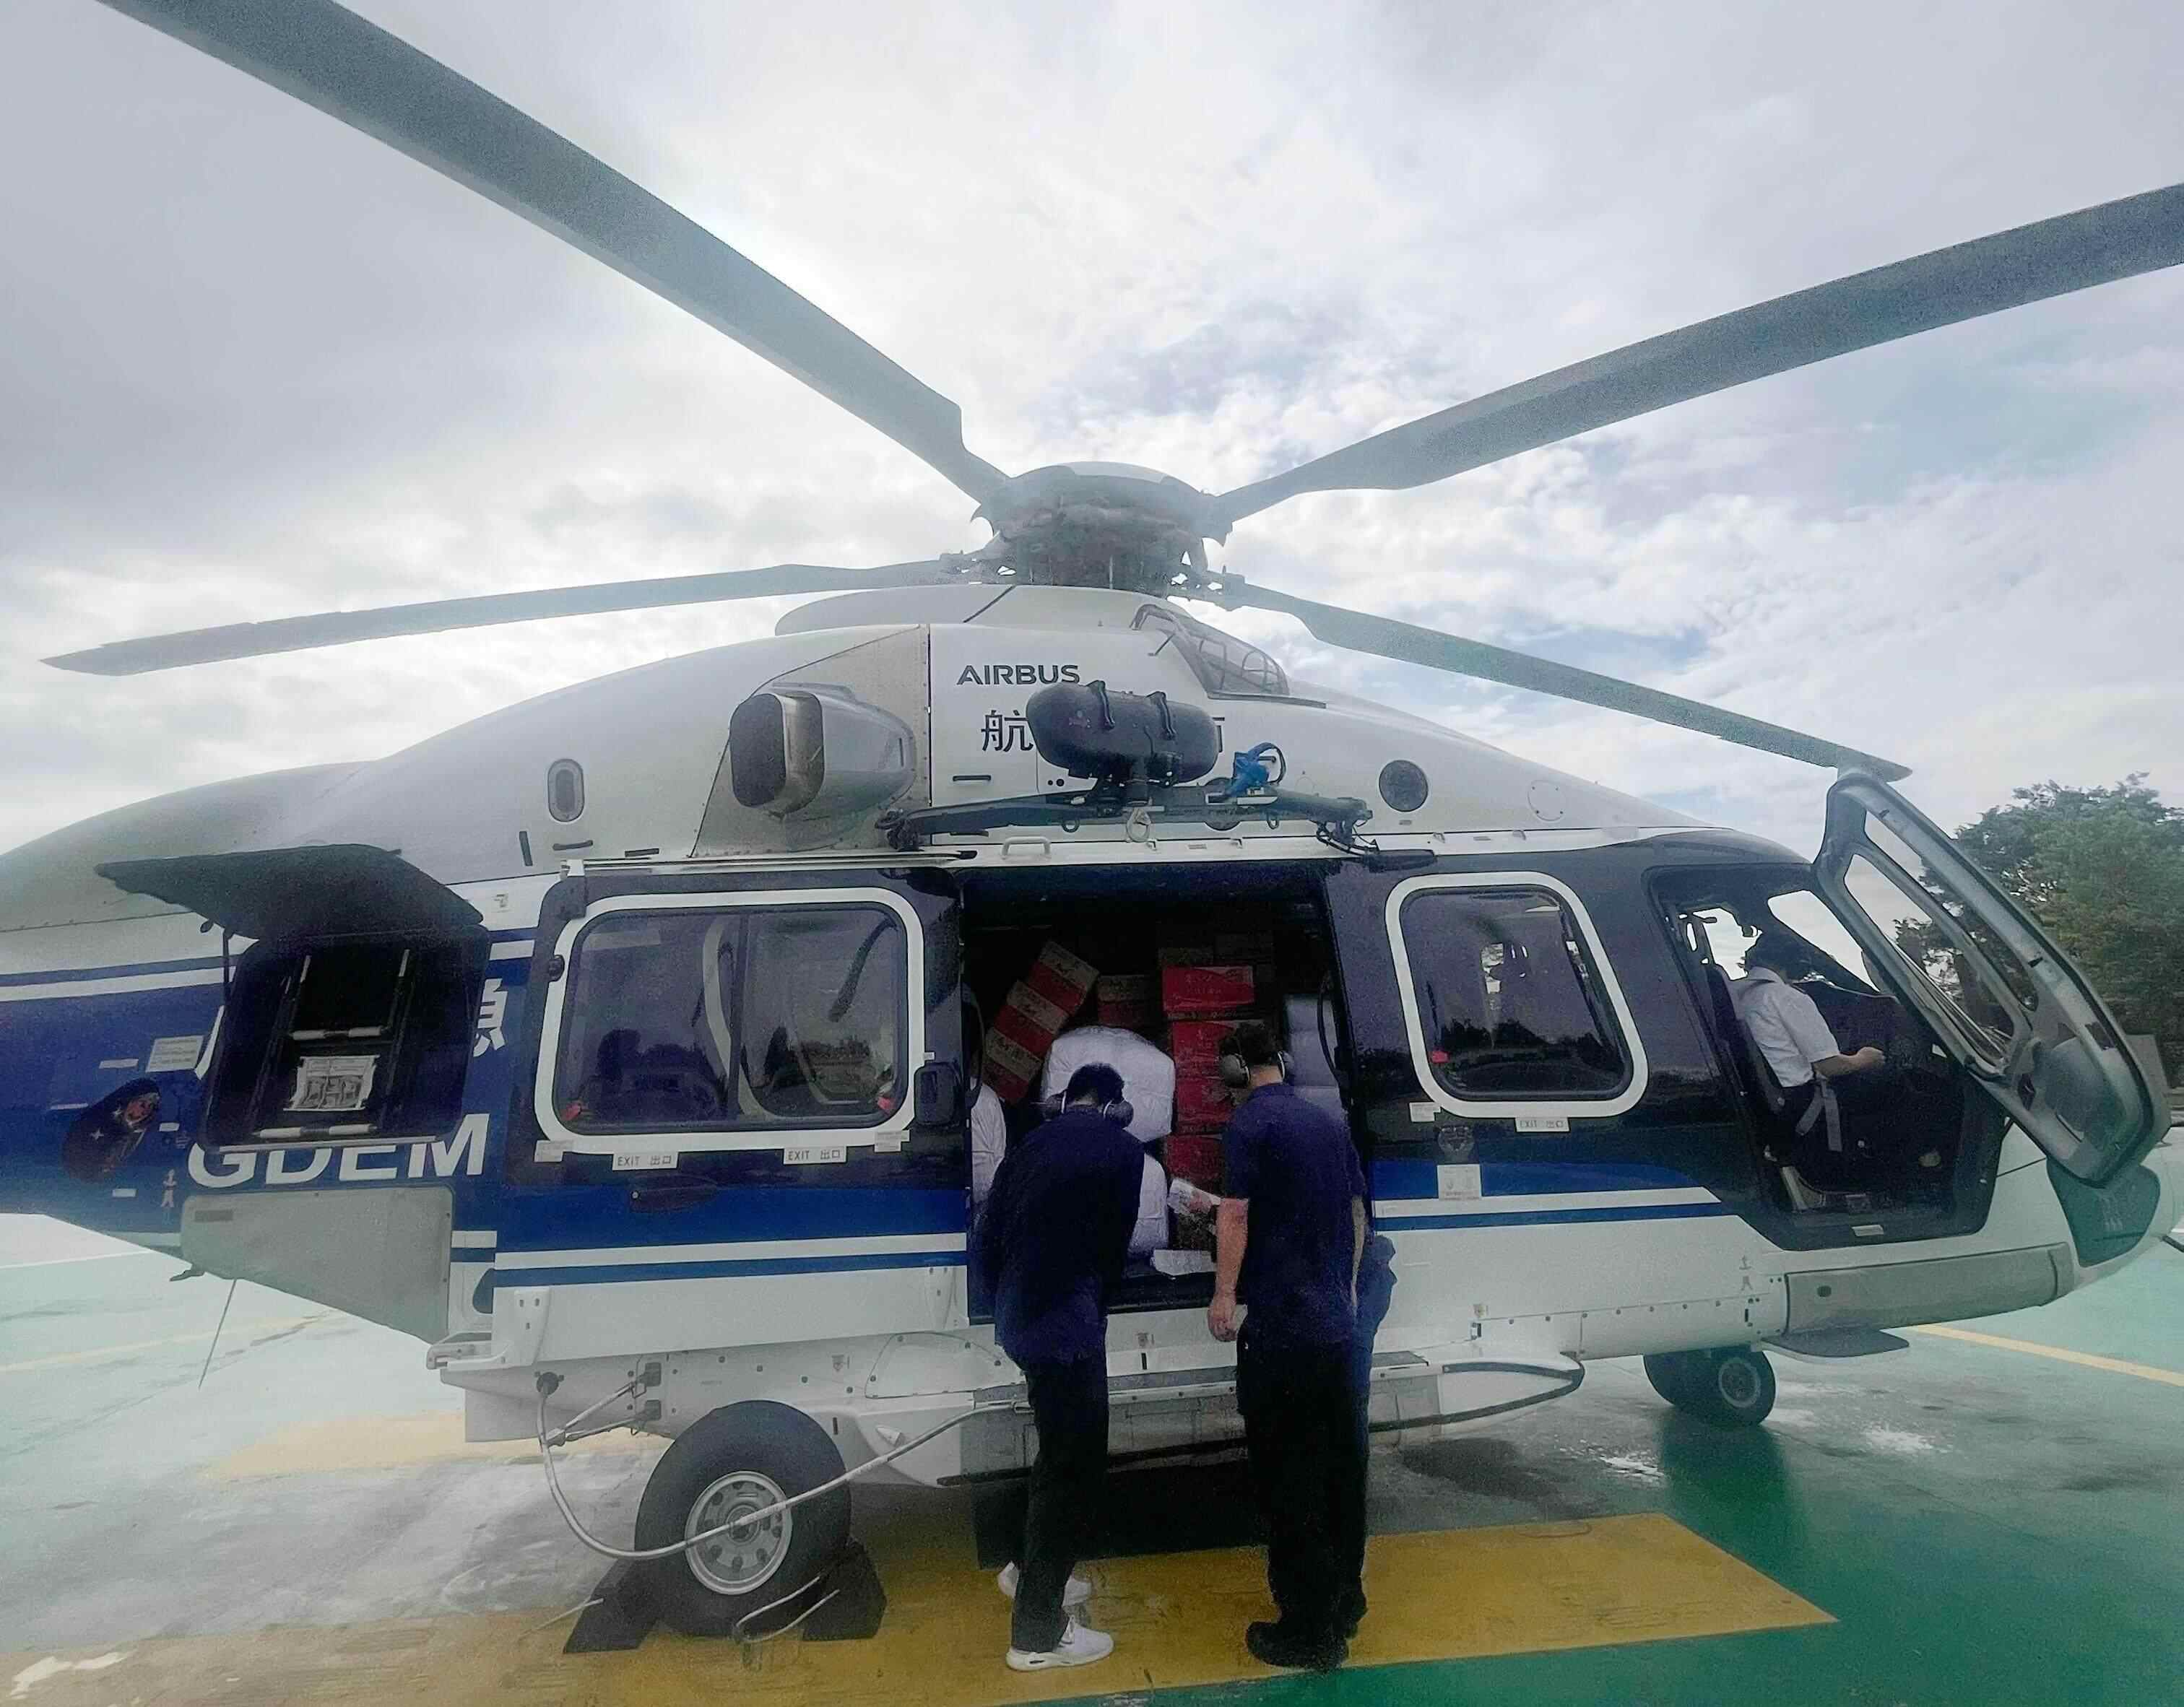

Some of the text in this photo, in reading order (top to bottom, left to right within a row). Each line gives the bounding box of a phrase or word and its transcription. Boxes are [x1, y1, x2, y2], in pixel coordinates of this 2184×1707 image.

[956, 664, 1081, 685] AIRBUS
[187, 1113, 491, 1189] GDEM
[787, 1149, 841, 1161] EXIT 出口
[618, 1155, 672, 1166] EXIT 出口
